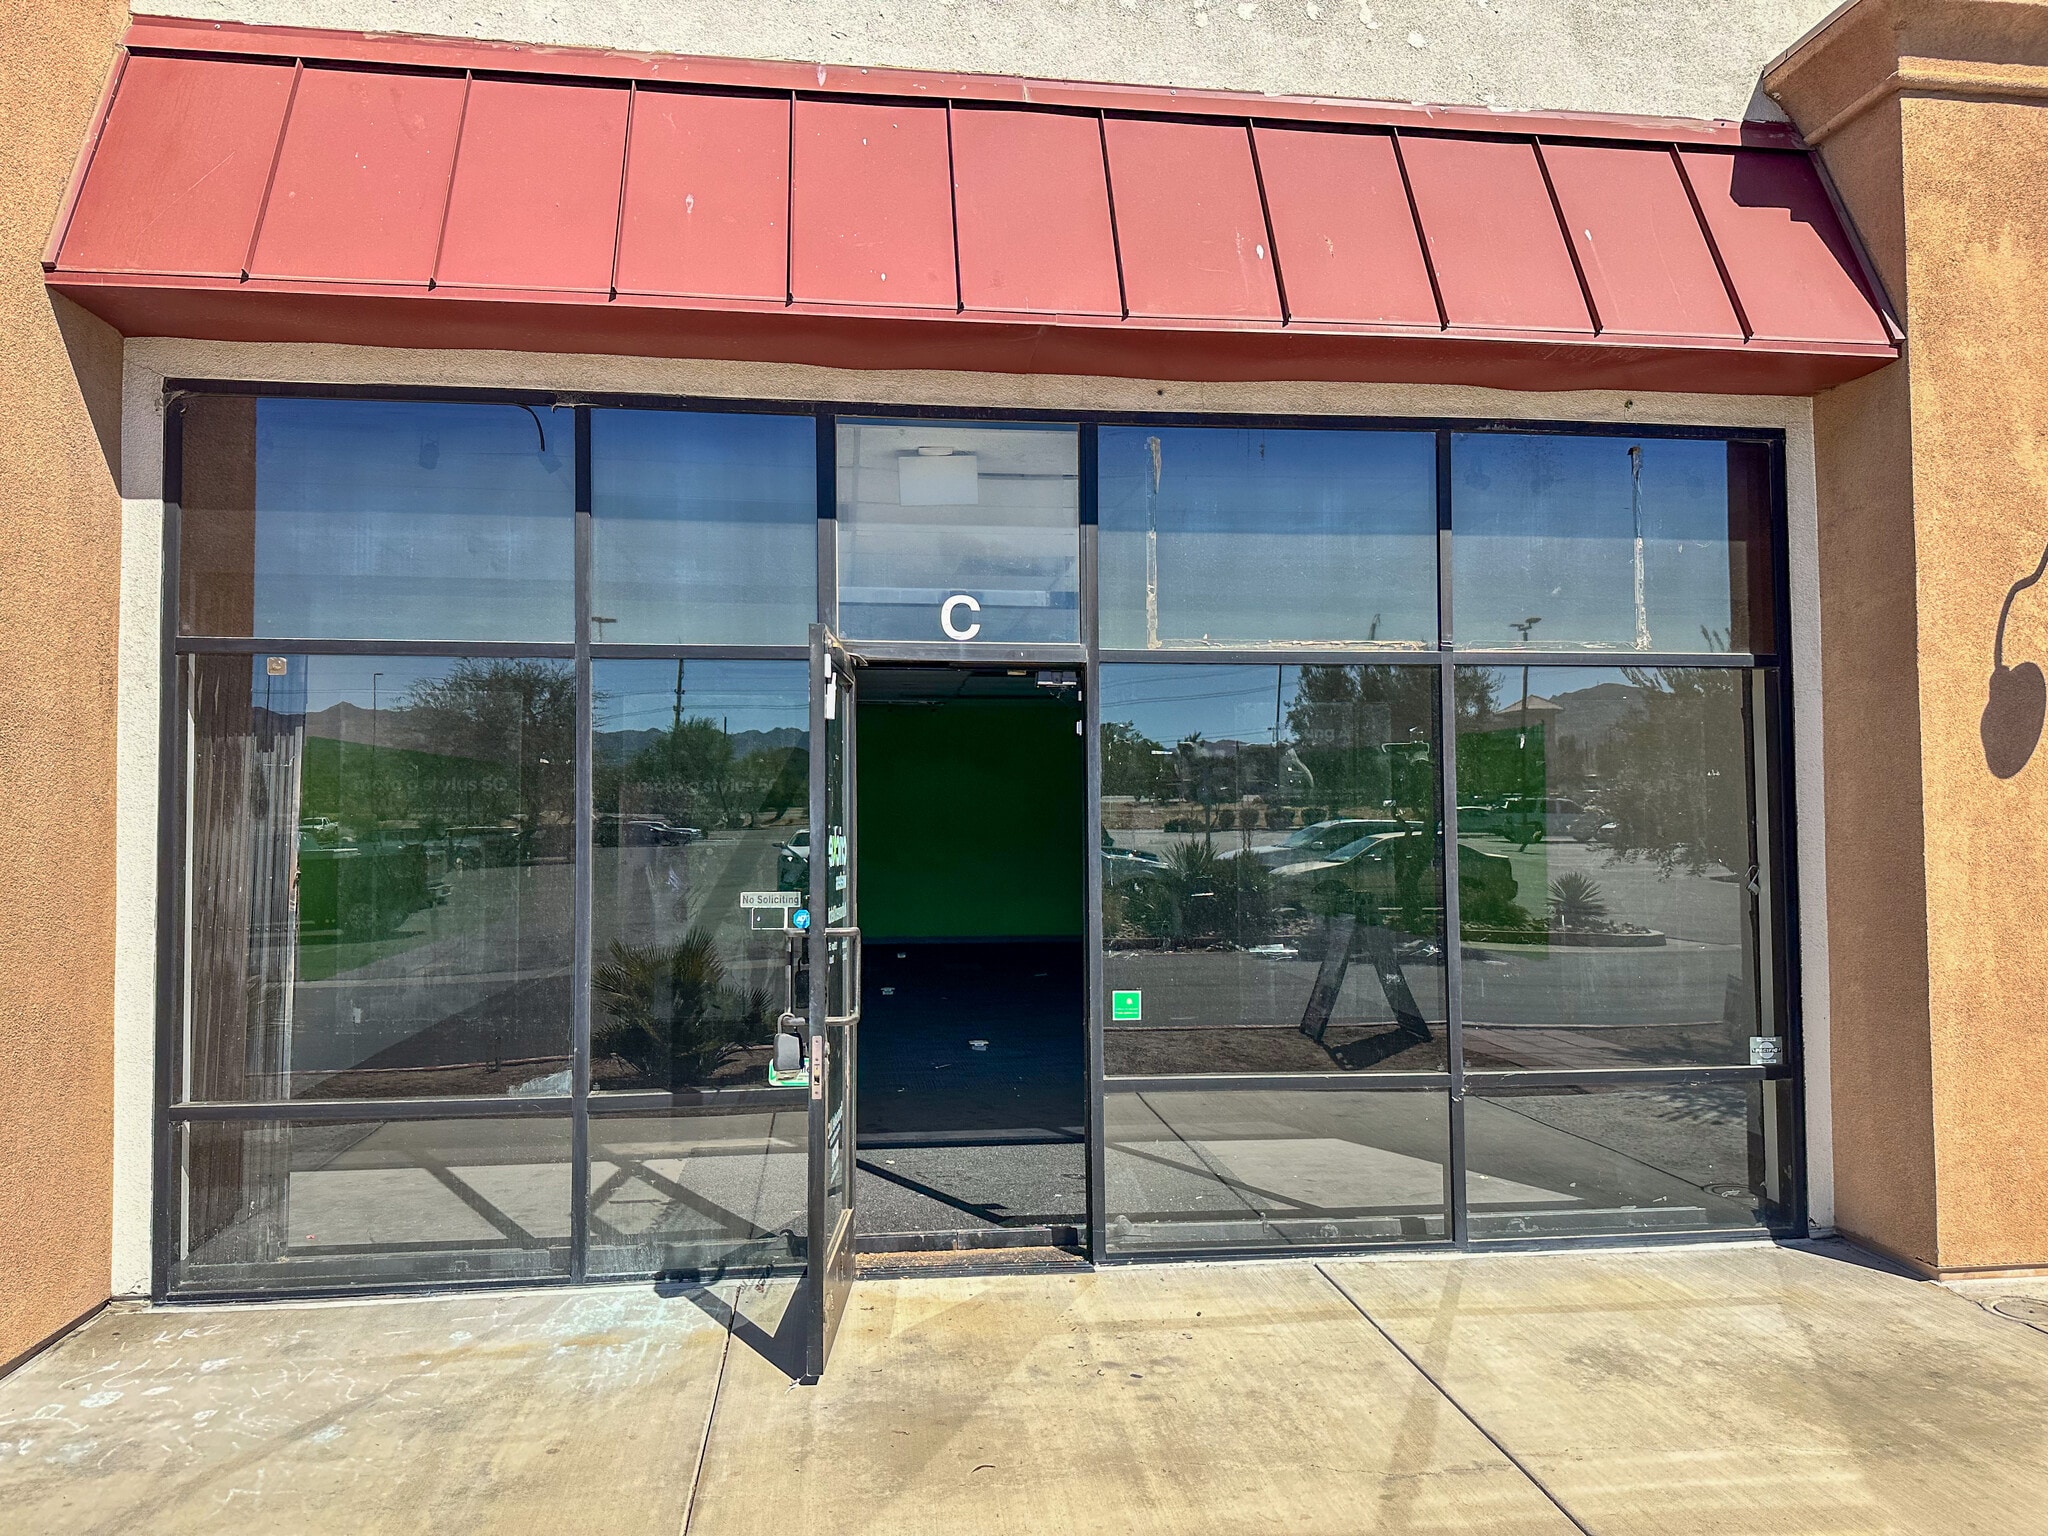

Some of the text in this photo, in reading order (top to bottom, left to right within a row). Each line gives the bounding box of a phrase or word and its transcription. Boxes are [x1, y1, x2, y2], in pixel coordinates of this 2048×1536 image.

[941, 594, 981, 641] C
[481, 776, 508, 792] 5G
[742, 894, 799, 906] No Soliciting
